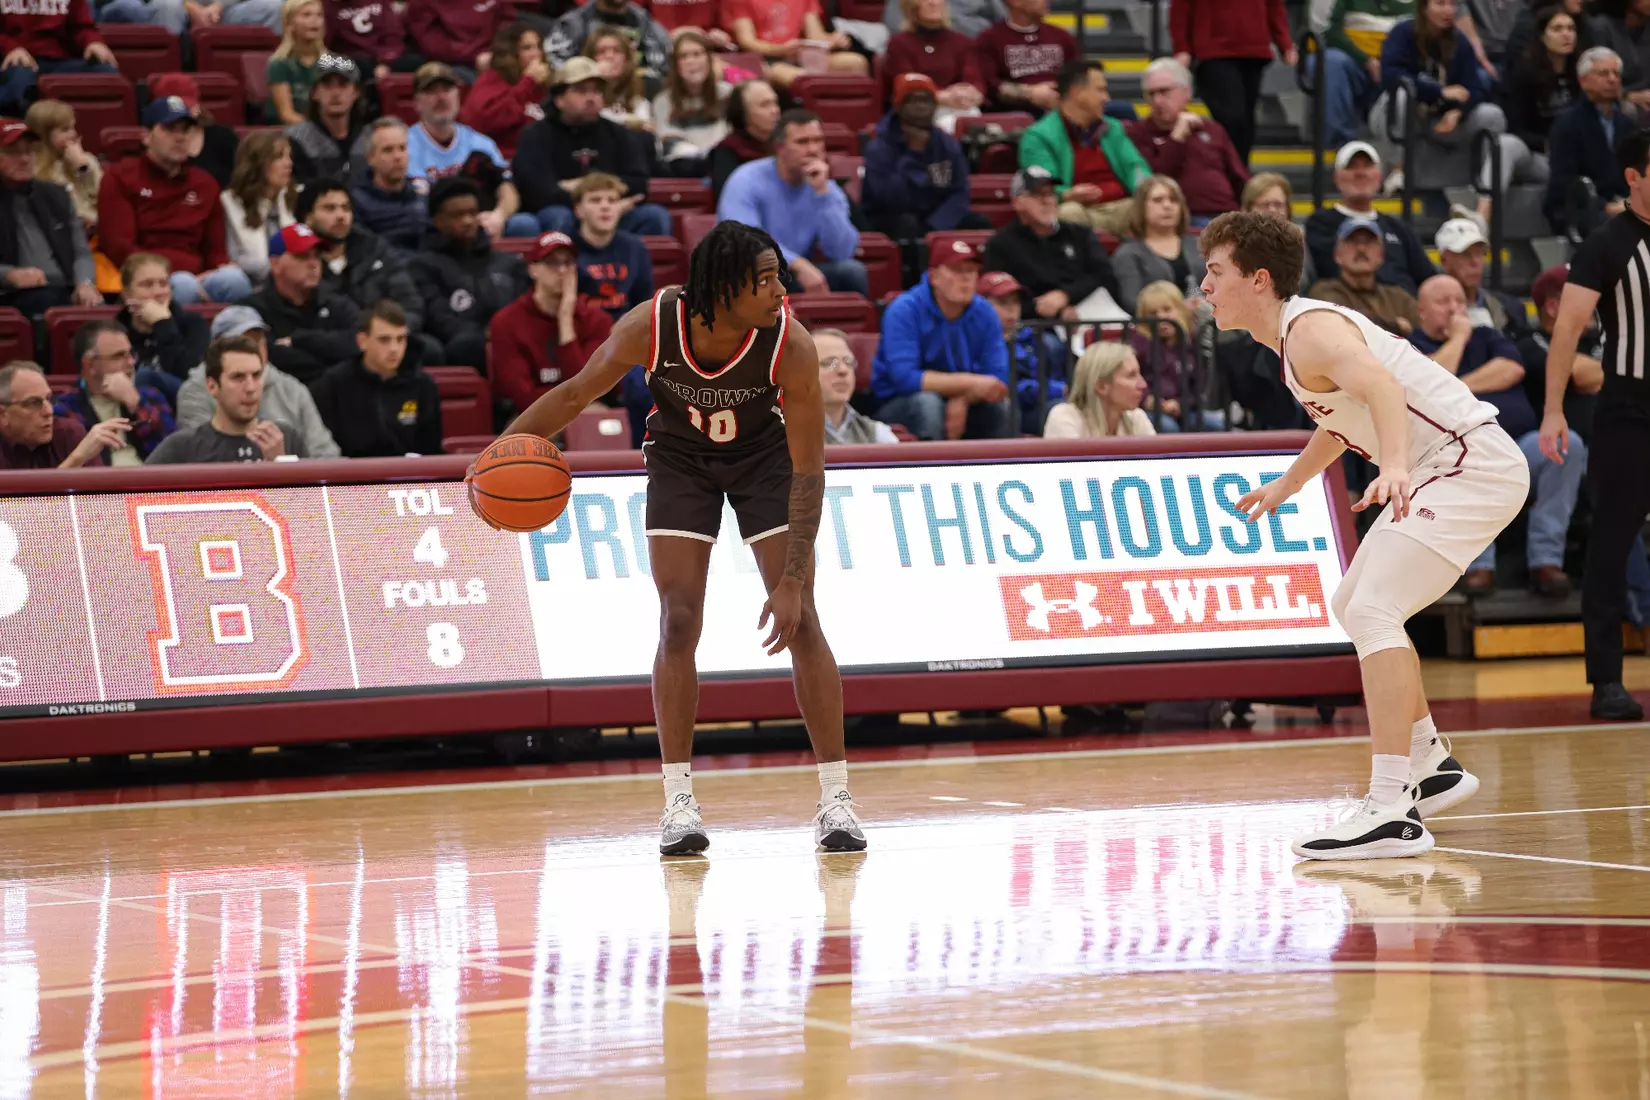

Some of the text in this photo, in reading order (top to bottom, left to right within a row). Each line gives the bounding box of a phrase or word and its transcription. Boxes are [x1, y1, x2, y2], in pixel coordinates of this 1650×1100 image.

[686, 404, 738, 444] 10
[388, 488, 454, 517] TOL
[872, 479, 1045, 568] THIS
[1058, 471, 1329, 561] HOUSE.
[413, 526, 450, 568] 4
[382, 578, 488, 609] FOULS
[1122, 575, 1322, 626] I WILL.
[426, 622, 465, 668] 8
[927, 659, 1005, 672] DAKTRONICS
[48, 702, 137, 716] DAKTRONICS
